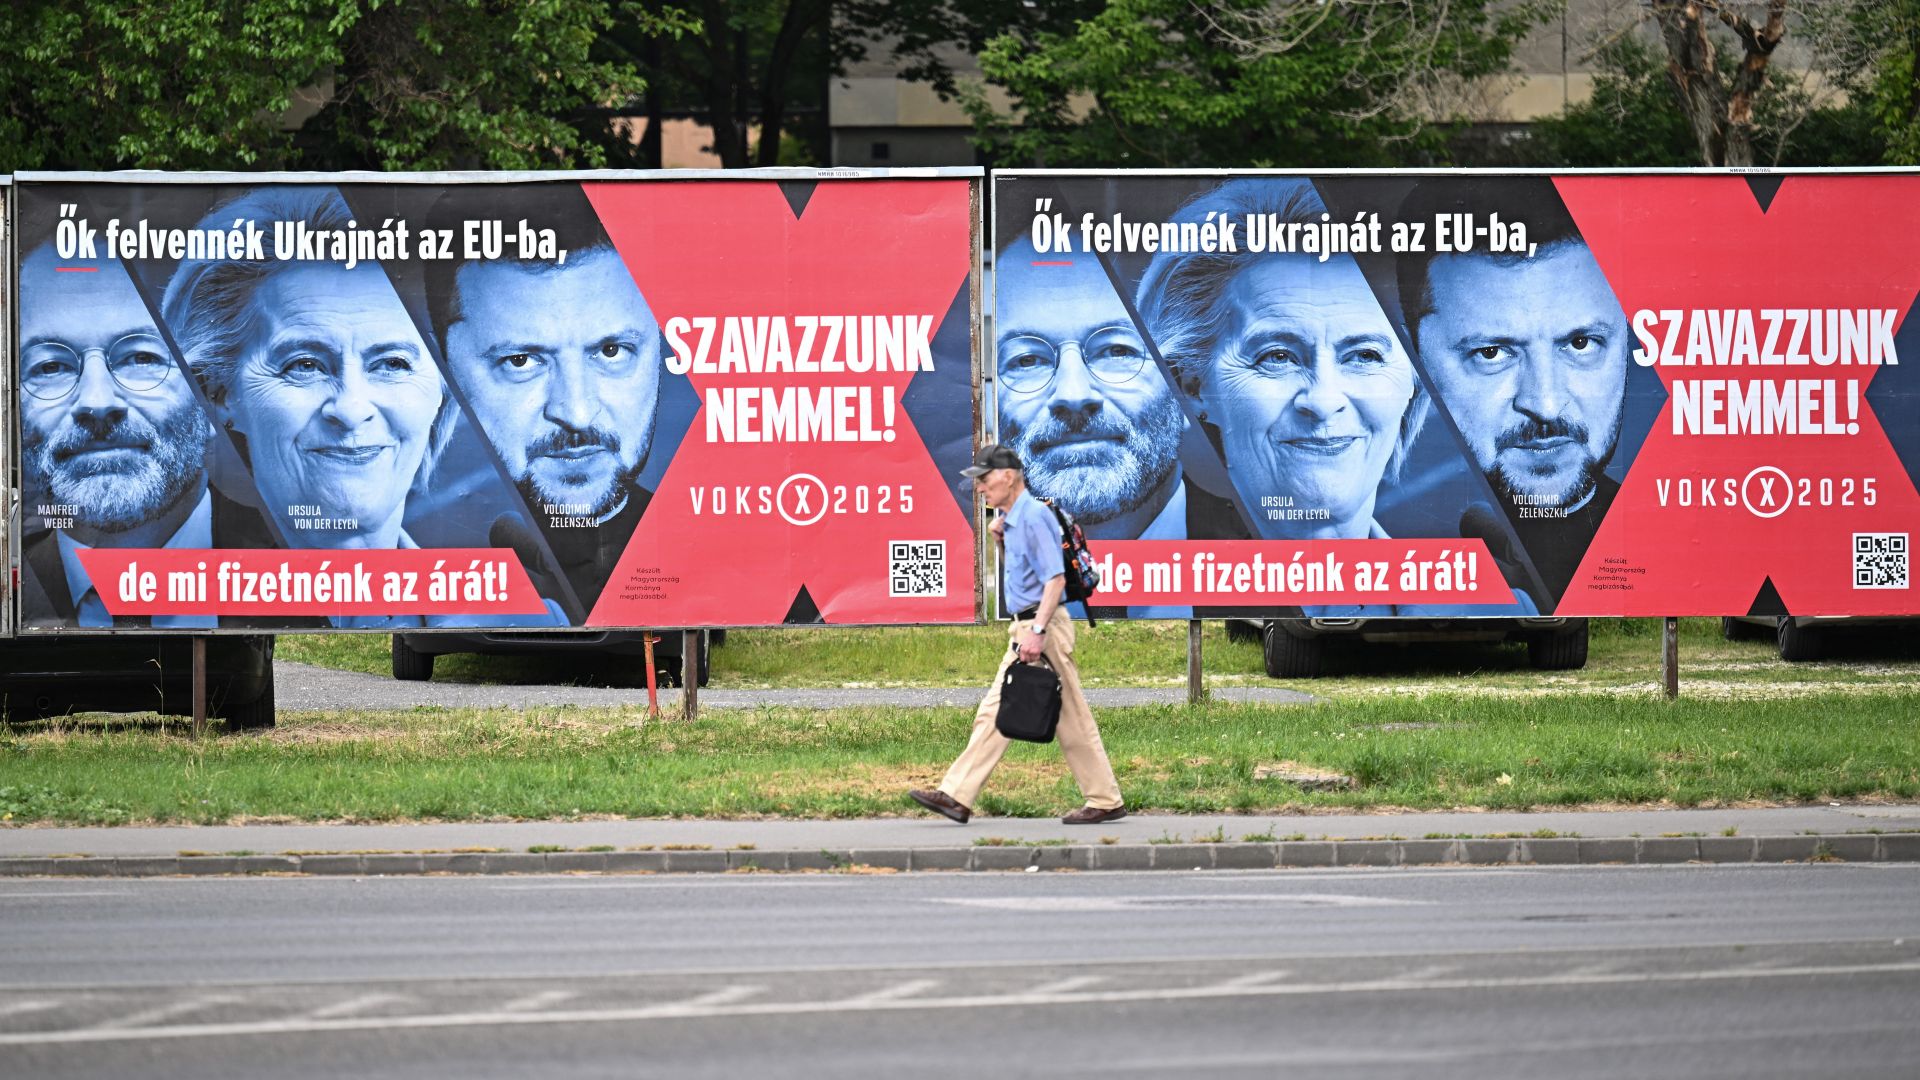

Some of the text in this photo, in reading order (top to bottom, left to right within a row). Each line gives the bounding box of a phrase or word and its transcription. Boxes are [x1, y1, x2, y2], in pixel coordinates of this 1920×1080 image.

[56, 204, 568, 270] Ők felvennék Ukrajnát az EU-ba,
[1031, 198, 1538, 263] Ők felvennék Ukrajnát az EU-ba,
[664, 314, 936, 375] SZAVAZZUNK
[1632, 309, 1899, 367] SZAVAZZUNK
[705, 385, 896, 443] NEMMEL!
[1672, 379, 1860, 435] NEMMEL!
[689, 485, 772, 515] VOKS
[833, 485, 914, 514] 2025
[1261, 495, 1294, 507] URSULA
[1512, 494, 1560, 505] VOLODIMIR
[1656, 478, 1737, 507] VOKS
[1798, 478, 1877, 506] 2025
[37, 504, 78, 516] MANFRED
[288, 504, 322, 516] URSULA
[543, 503, 591, 515] VOLODIMIR
[1267, 508, 1330, 520] VON DER LEYEN
[1519, 507, 1568, 518] ZELENSZKIJ
[43, 517, 74, 529] WEBER
[294, 518, 358, 530] VON DER LEYEN
[550, 516, 600, 528] ZELENSZKIJ
[118, 559, 508, 603] de mi fizetnénk az árát!
[1096, 549, 1478, 593] de mi fizetnénk az árát!
